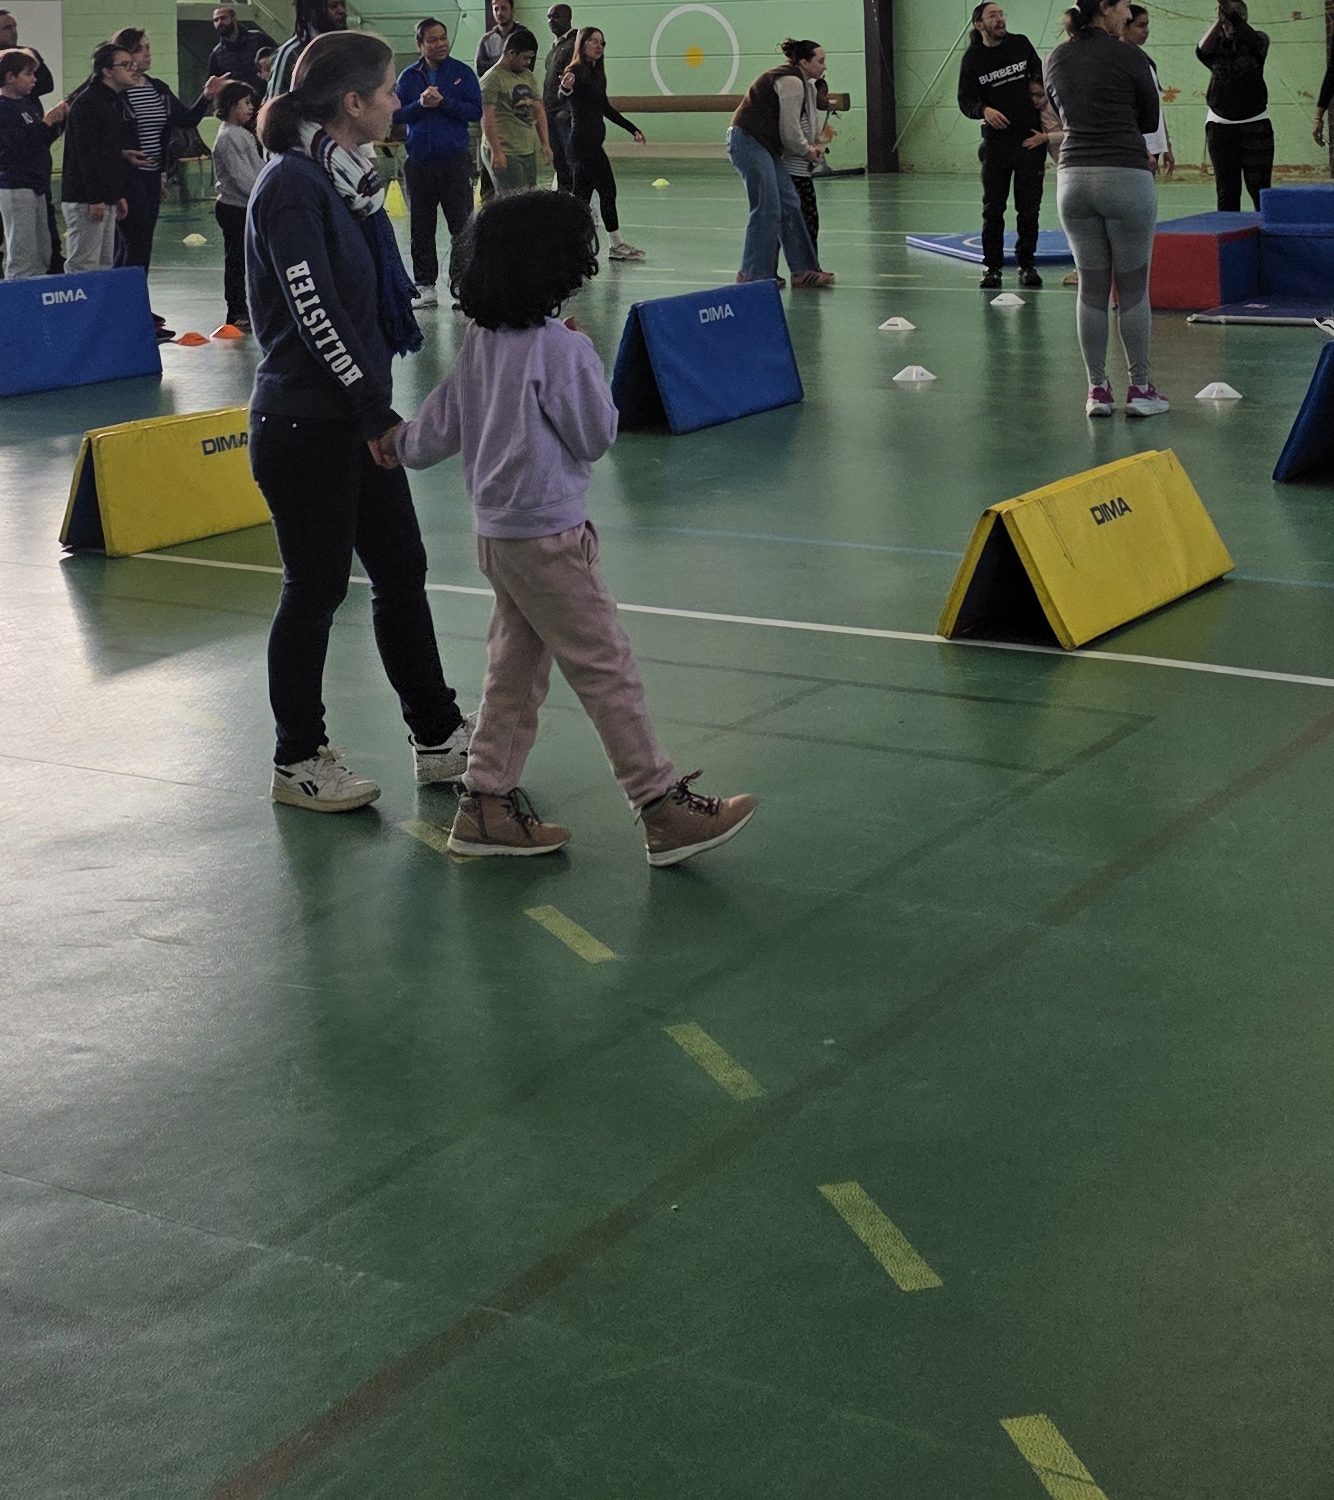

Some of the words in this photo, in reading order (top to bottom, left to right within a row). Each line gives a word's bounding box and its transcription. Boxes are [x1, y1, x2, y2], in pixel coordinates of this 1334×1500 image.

[41, 288, 87, 306] DIMA
[286, 260, 364, 387] HOLLISTER
[698, 303, 735, 324] DIMA
[201, 431, 249, 456] DIMA
[1089, 496, 1133, 526] DIMA
